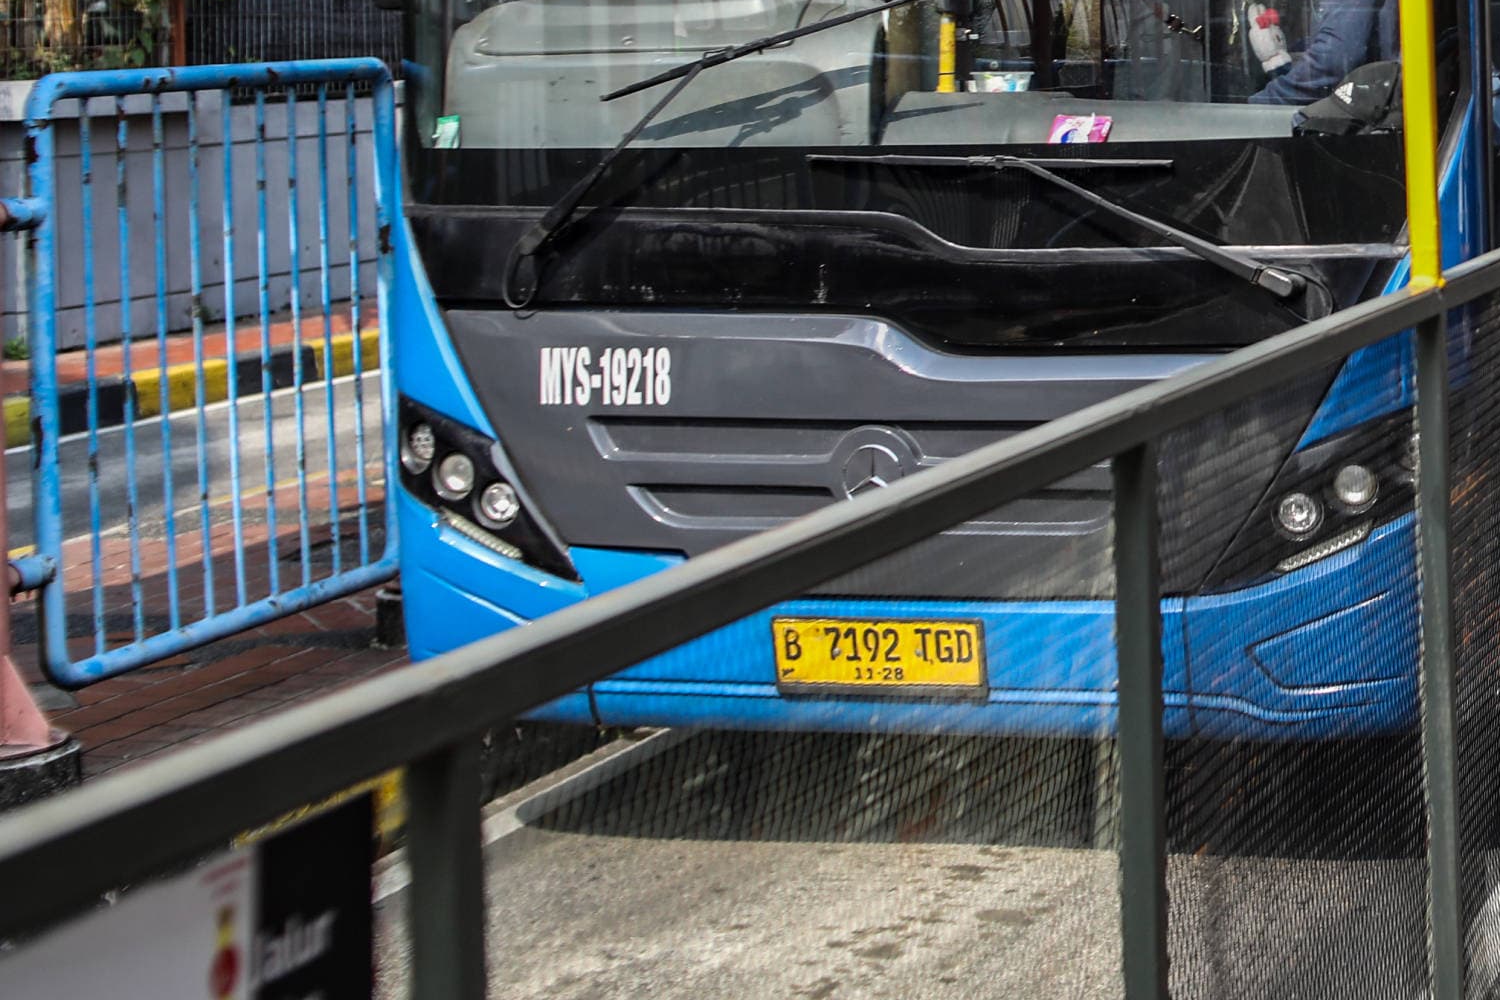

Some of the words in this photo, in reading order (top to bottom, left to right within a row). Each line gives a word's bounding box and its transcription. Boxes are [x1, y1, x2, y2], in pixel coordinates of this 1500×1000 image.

[540, 346, 672, 406] MYS-19218
[784, 628, 802, 661] B
[824, 627, 901, 662] 7192
[914, 628, 973, 664] TGD
